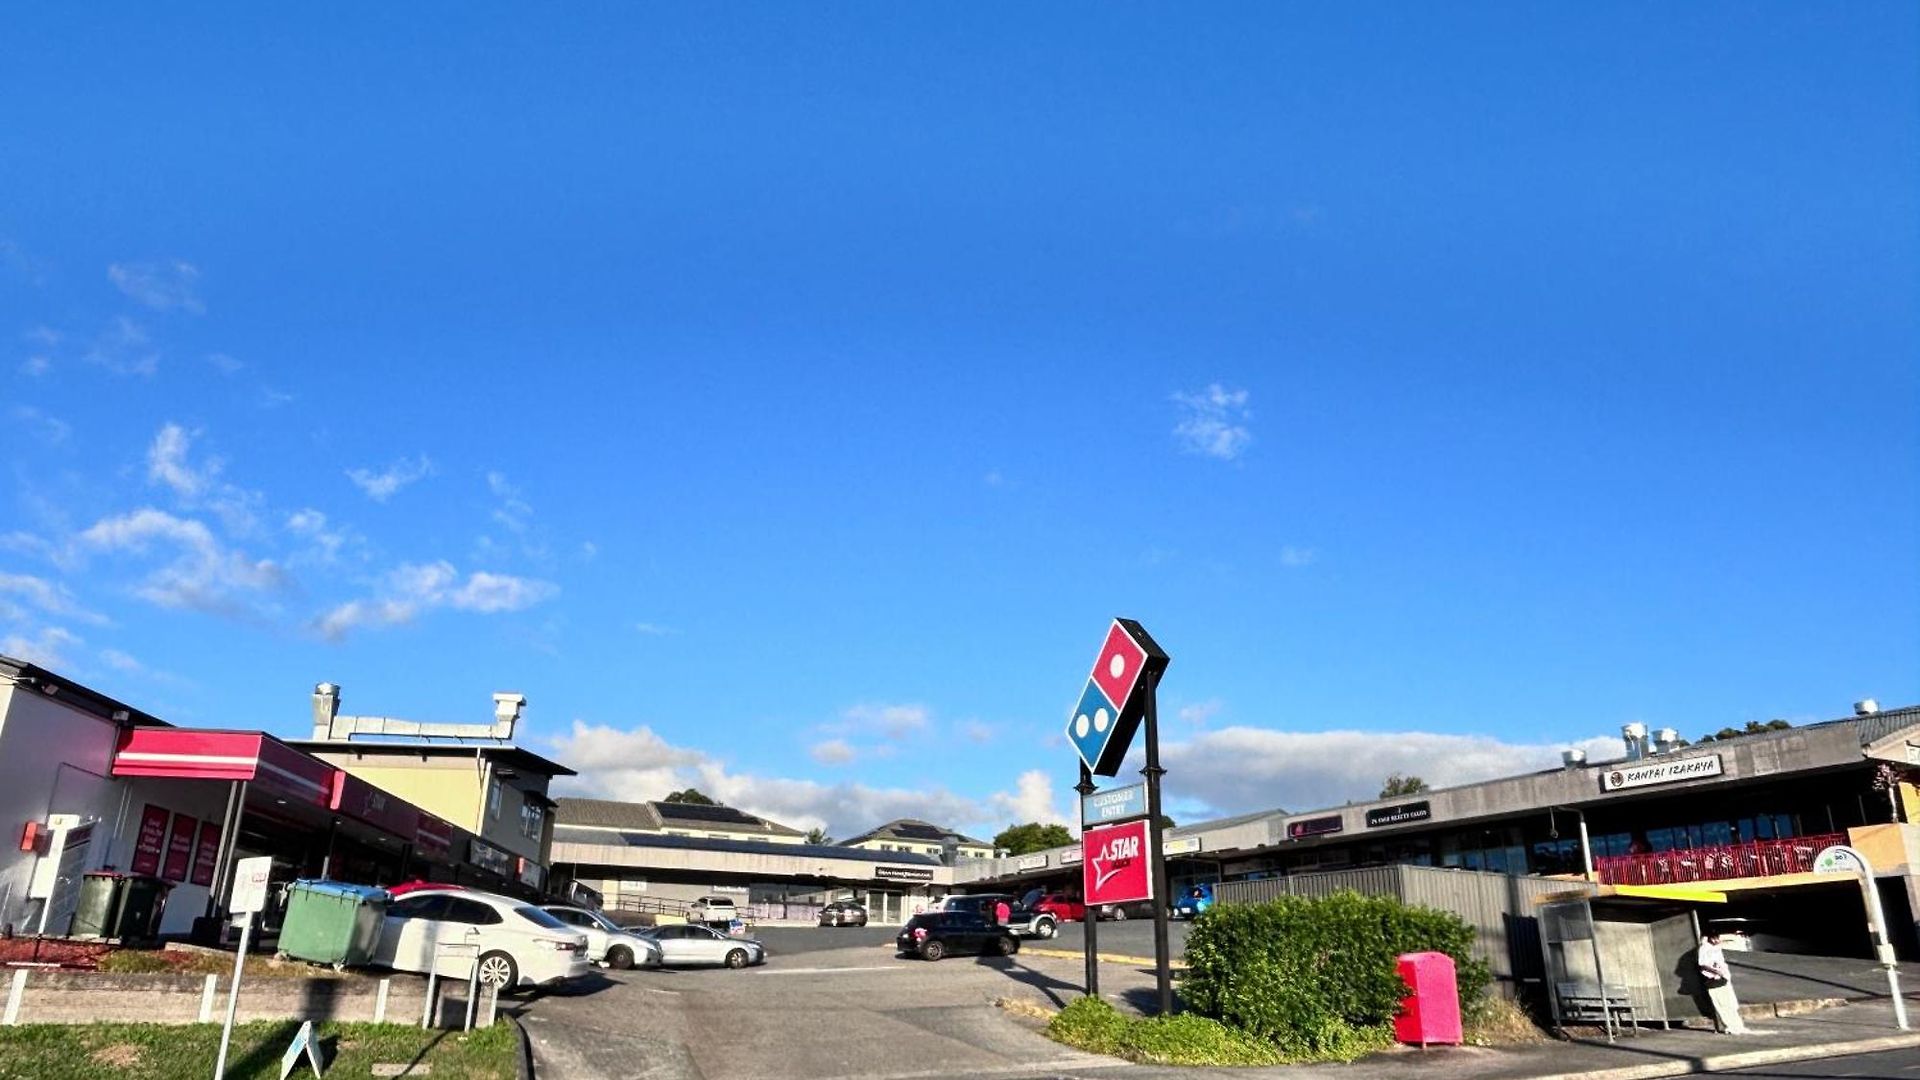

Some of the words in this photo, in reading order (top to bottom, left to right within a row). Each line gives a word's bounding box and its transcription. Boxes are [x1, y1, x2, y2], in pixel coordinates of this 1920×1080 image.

[1627, 769, 1665, 781] KANPAI
[1668, 760, 1714, 775] IZAKAYA
[1094, 790, 1133, 806] CUSTOMER
[1102, 804, 1126, 818] ENTRY
[1111, 836, 1138, 860] STAR
